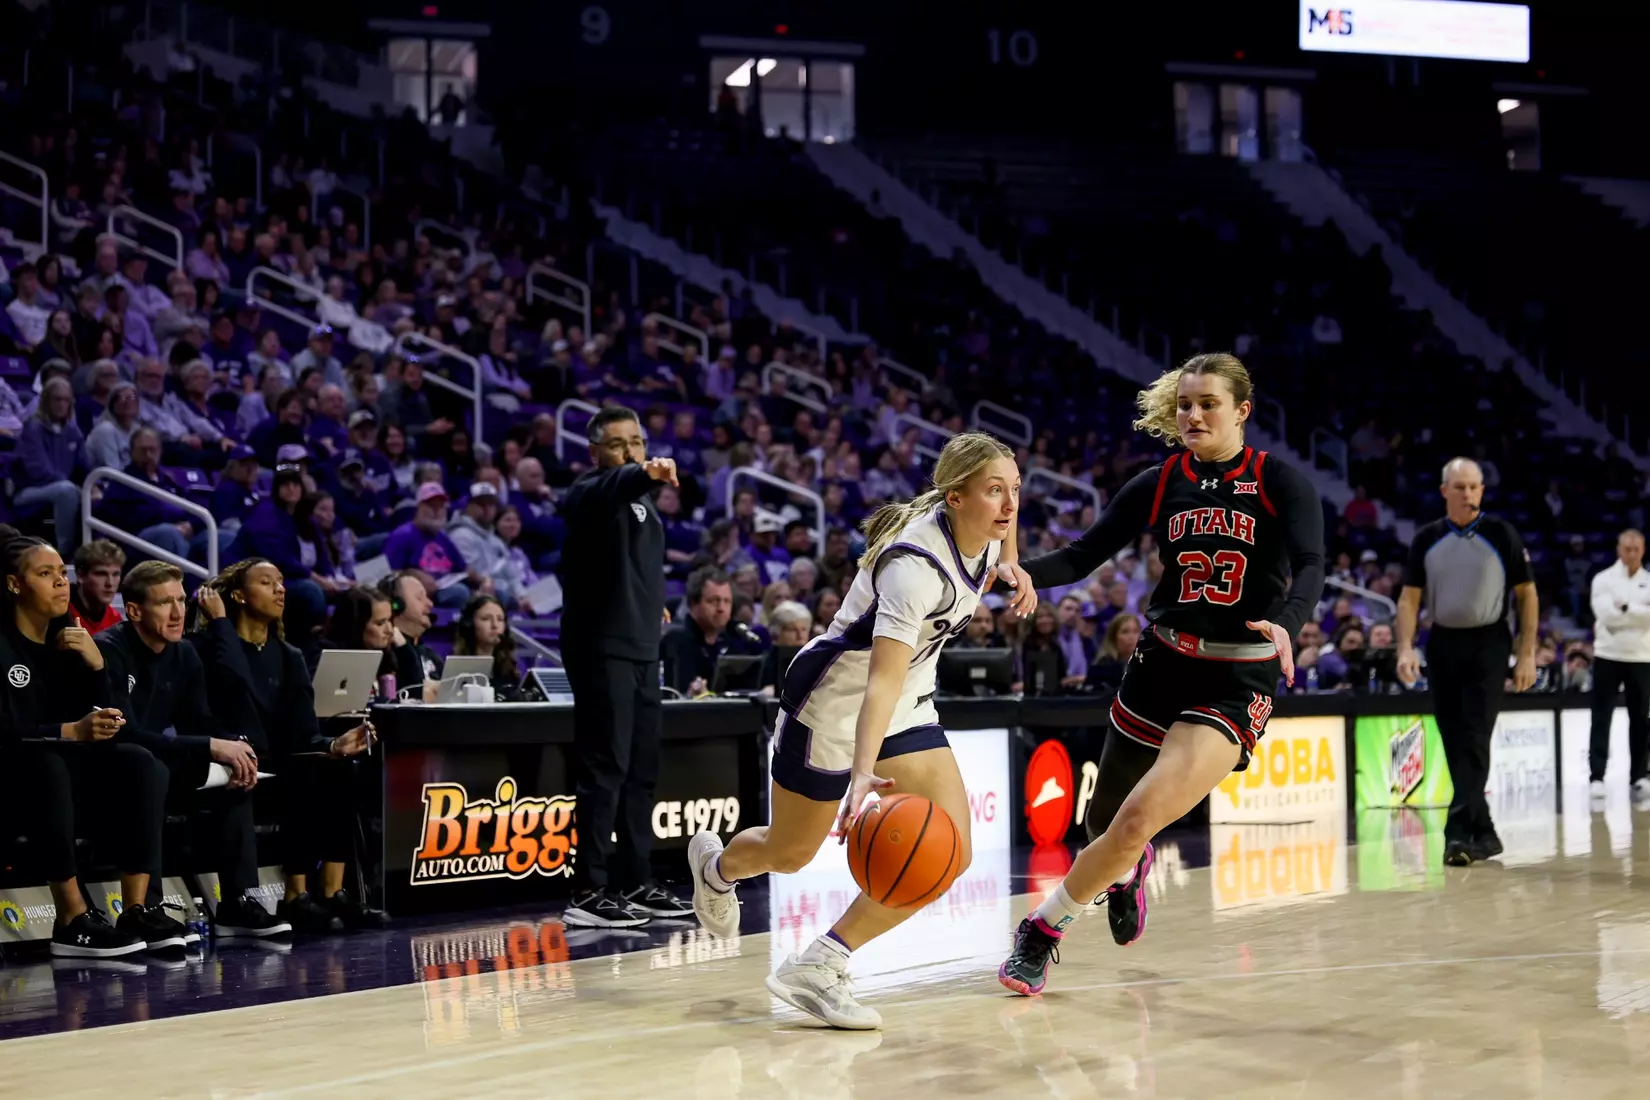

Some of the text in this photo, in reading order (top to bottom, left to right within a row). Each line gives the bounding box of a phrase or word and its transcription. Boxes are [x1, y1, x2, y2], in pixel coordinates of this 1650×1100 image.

[579, 3, 613, 46] 9
[987, 27, 1040, 67] 10
[1169, 507, 1255, 546] UTAH
[1177, 550, 1247, 606] 23
[418, 781, 578, 873] Brigg
[683, 796, 740, 836] 1979
[416, 854, 506, 879] AUTO.COM
